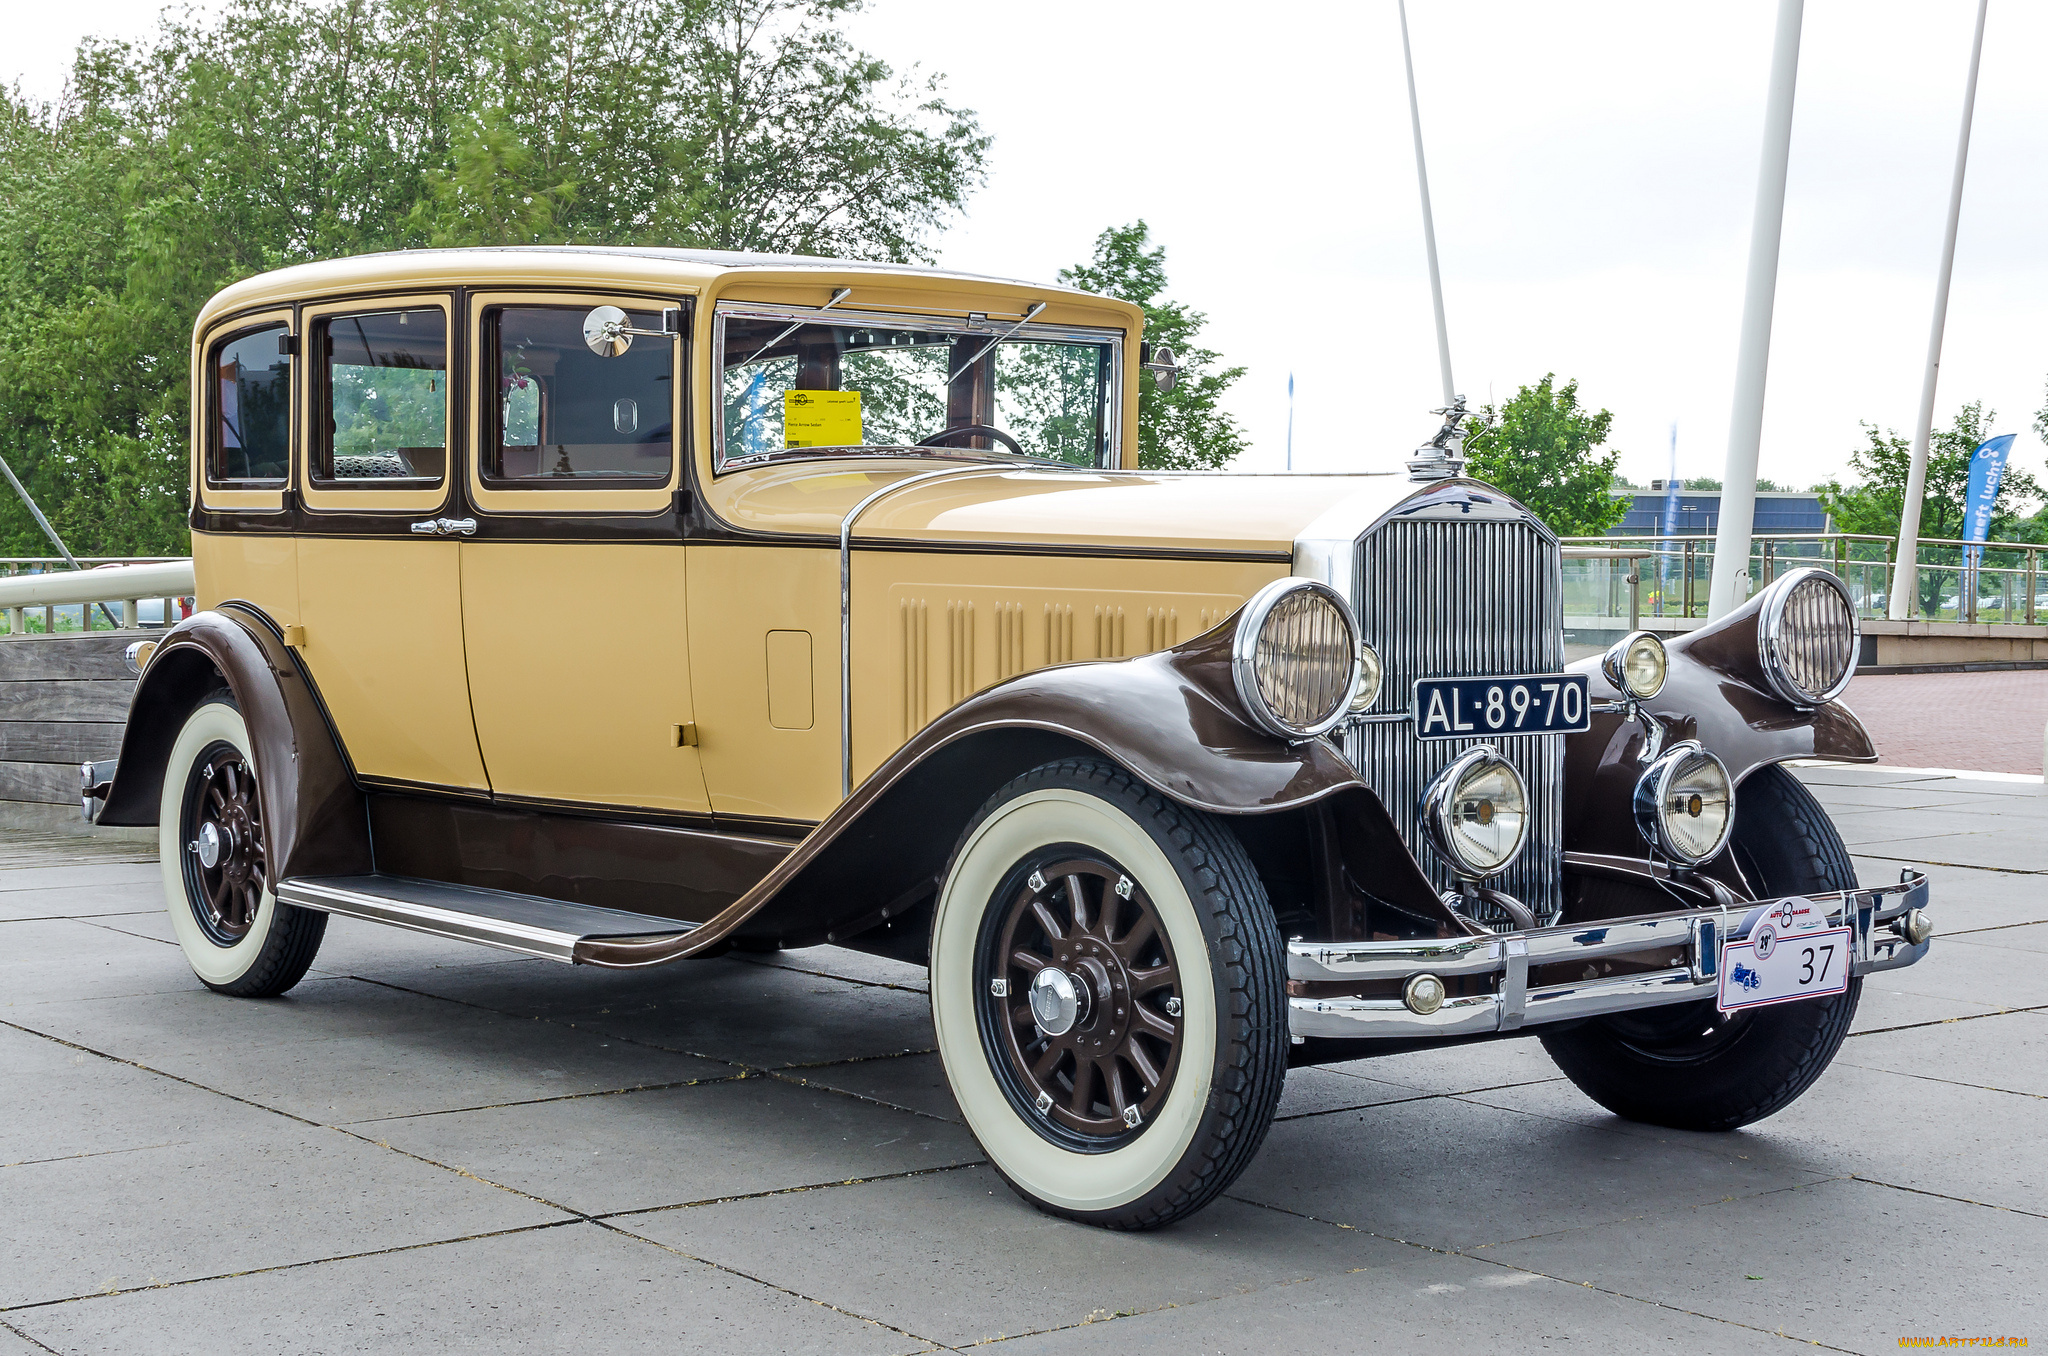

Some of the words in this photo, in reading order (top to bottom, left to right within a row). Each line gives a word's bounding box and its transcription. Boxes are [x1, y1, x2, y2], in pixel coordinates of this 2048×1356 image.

[1980, 459, 2002, 500] lucht
[1781, 901, 1793, 928] 8
[1798, 944, 1835, 985] 37
